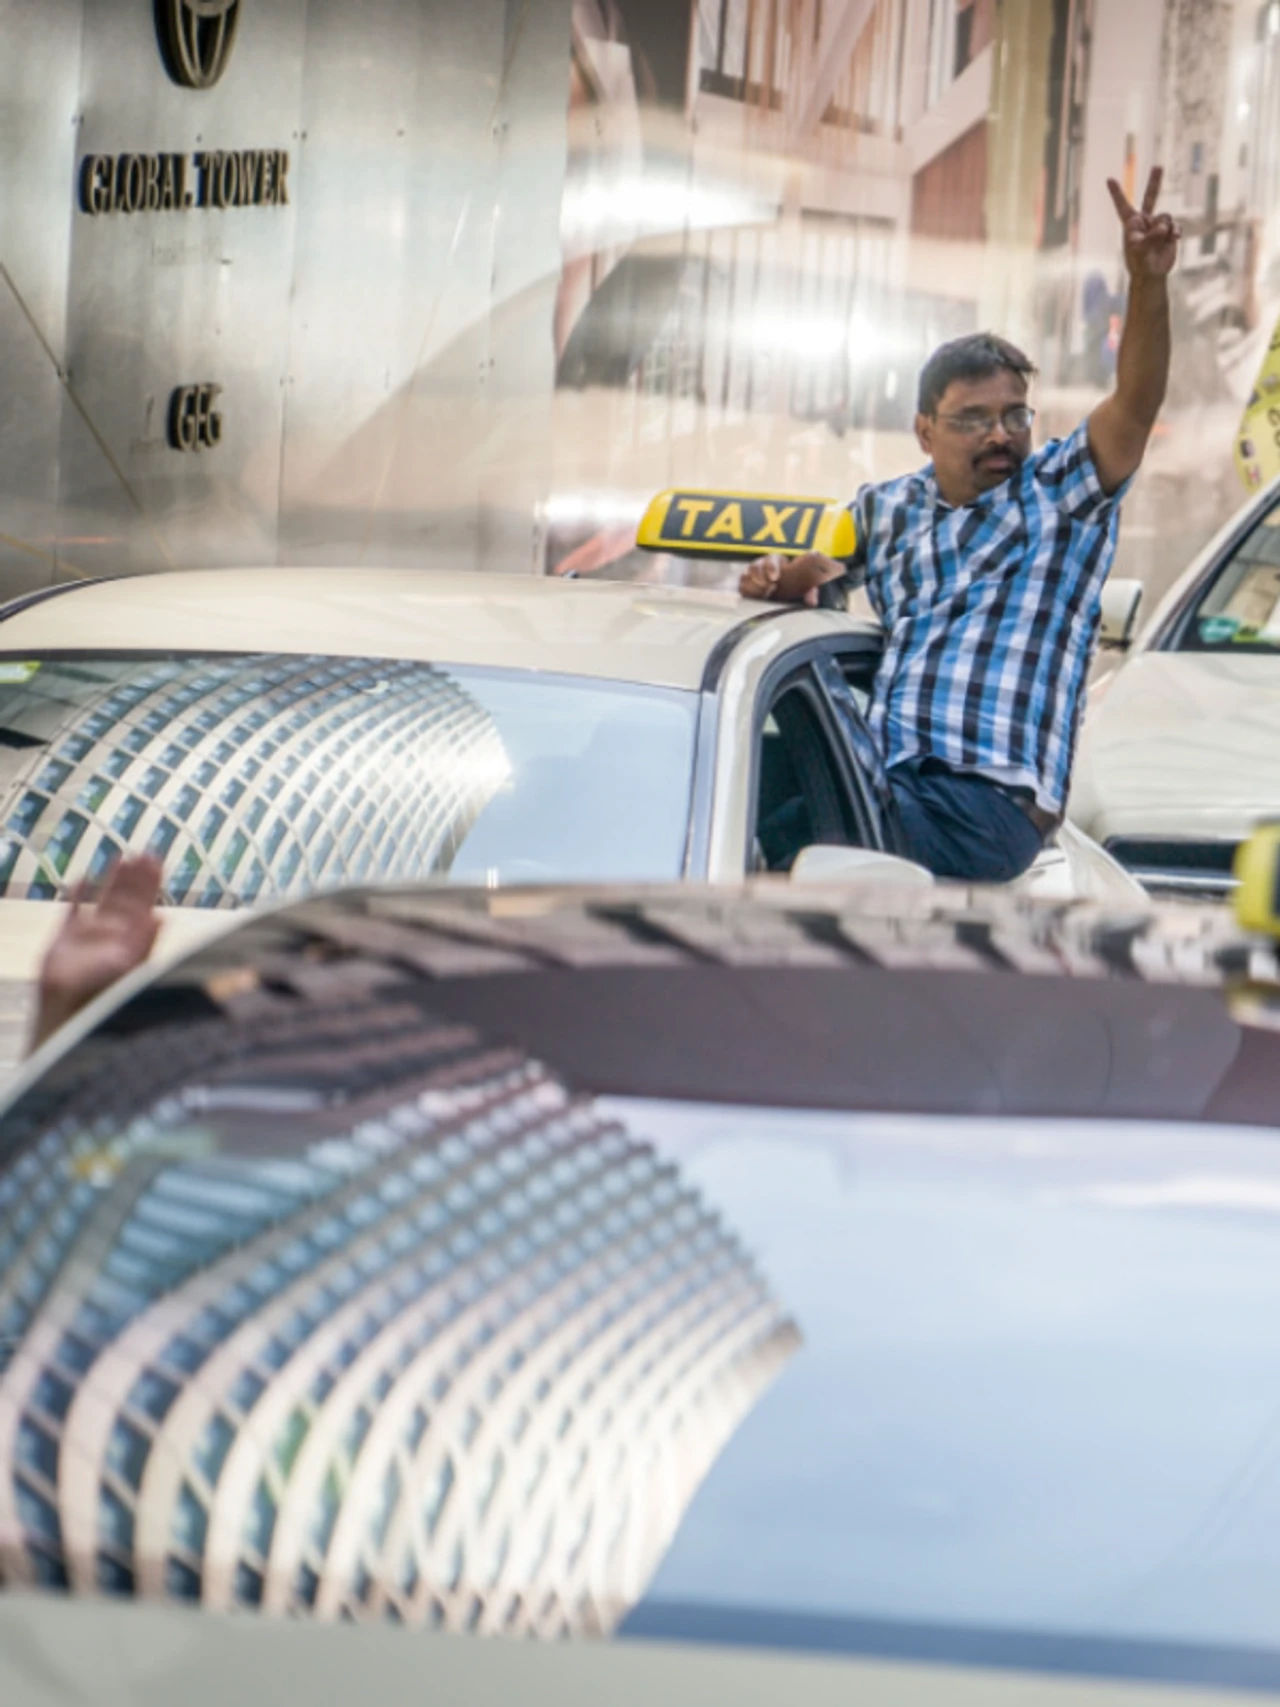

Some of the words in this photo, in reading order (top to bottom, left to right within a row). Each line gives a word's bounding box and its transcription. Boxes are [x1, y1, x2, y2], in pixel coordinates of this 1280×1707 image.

[78, 152, 193, 214] GLOBAL
[193, 149, 289, 208] TOWER
[676, 499, 816, 544] TAXI
